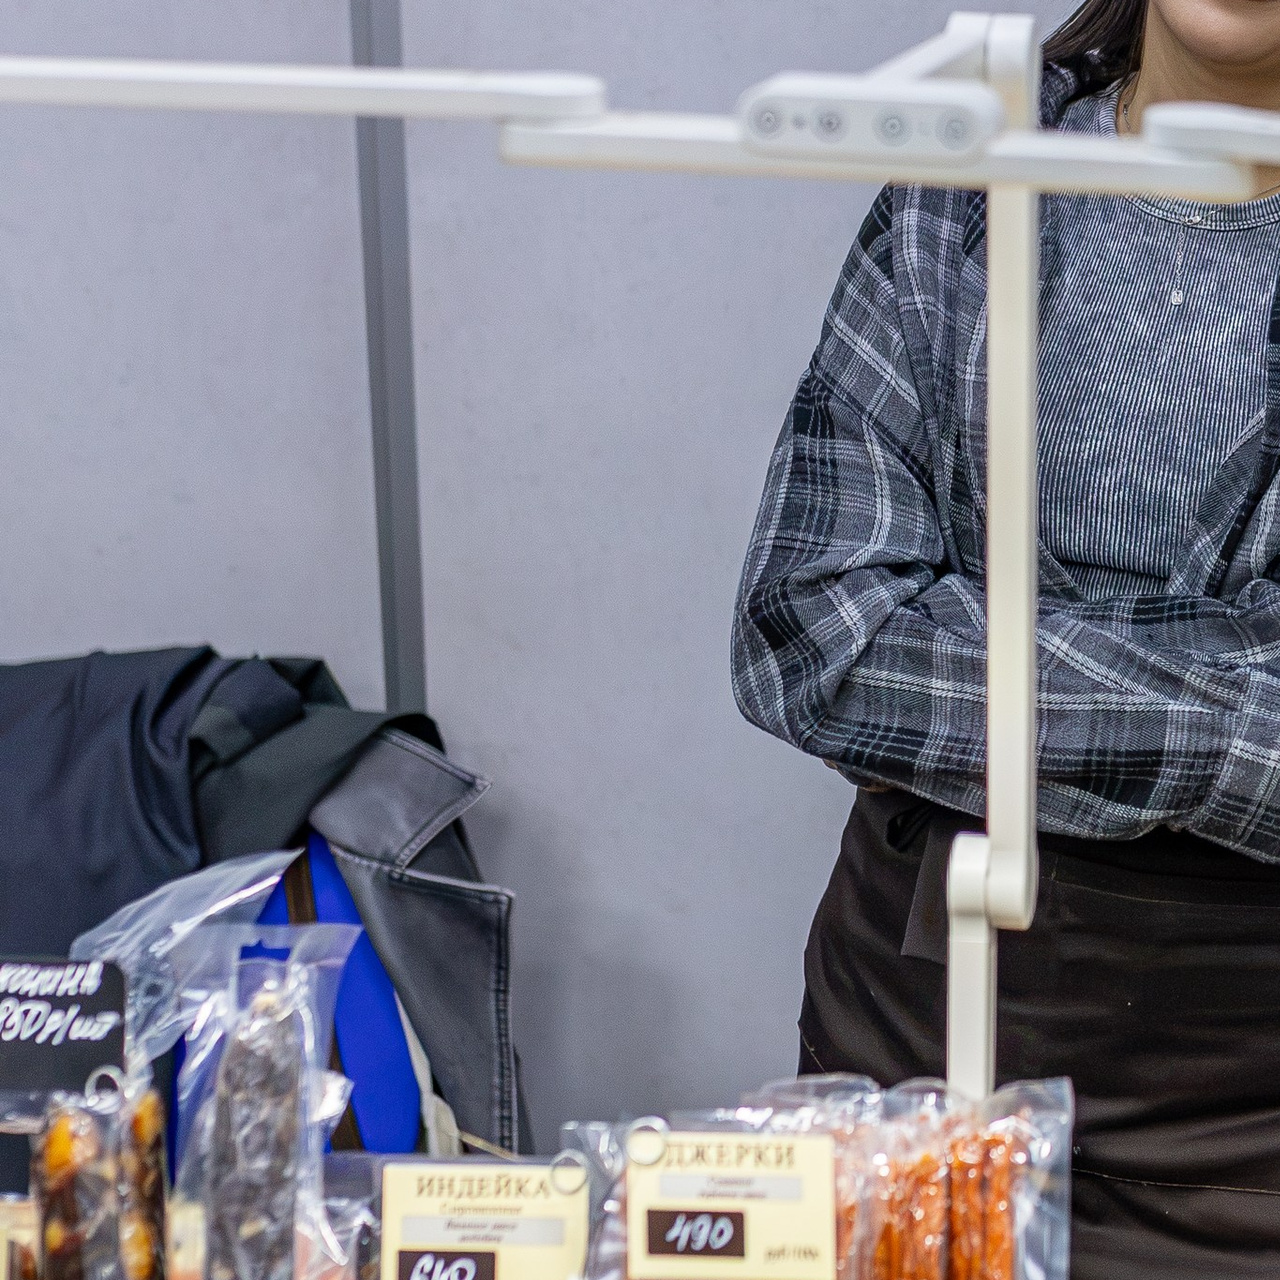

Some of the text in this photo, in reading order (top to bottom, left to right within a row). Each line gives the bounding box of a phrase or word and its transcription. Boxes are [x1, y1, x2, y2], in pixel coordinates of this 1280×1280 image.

[664, 1141, 796, 1169] ДЖЕРКИ
[416, 1173, 551, 1200] ИНДЕЙКА
[665, 1213, 735, 1252] 490
